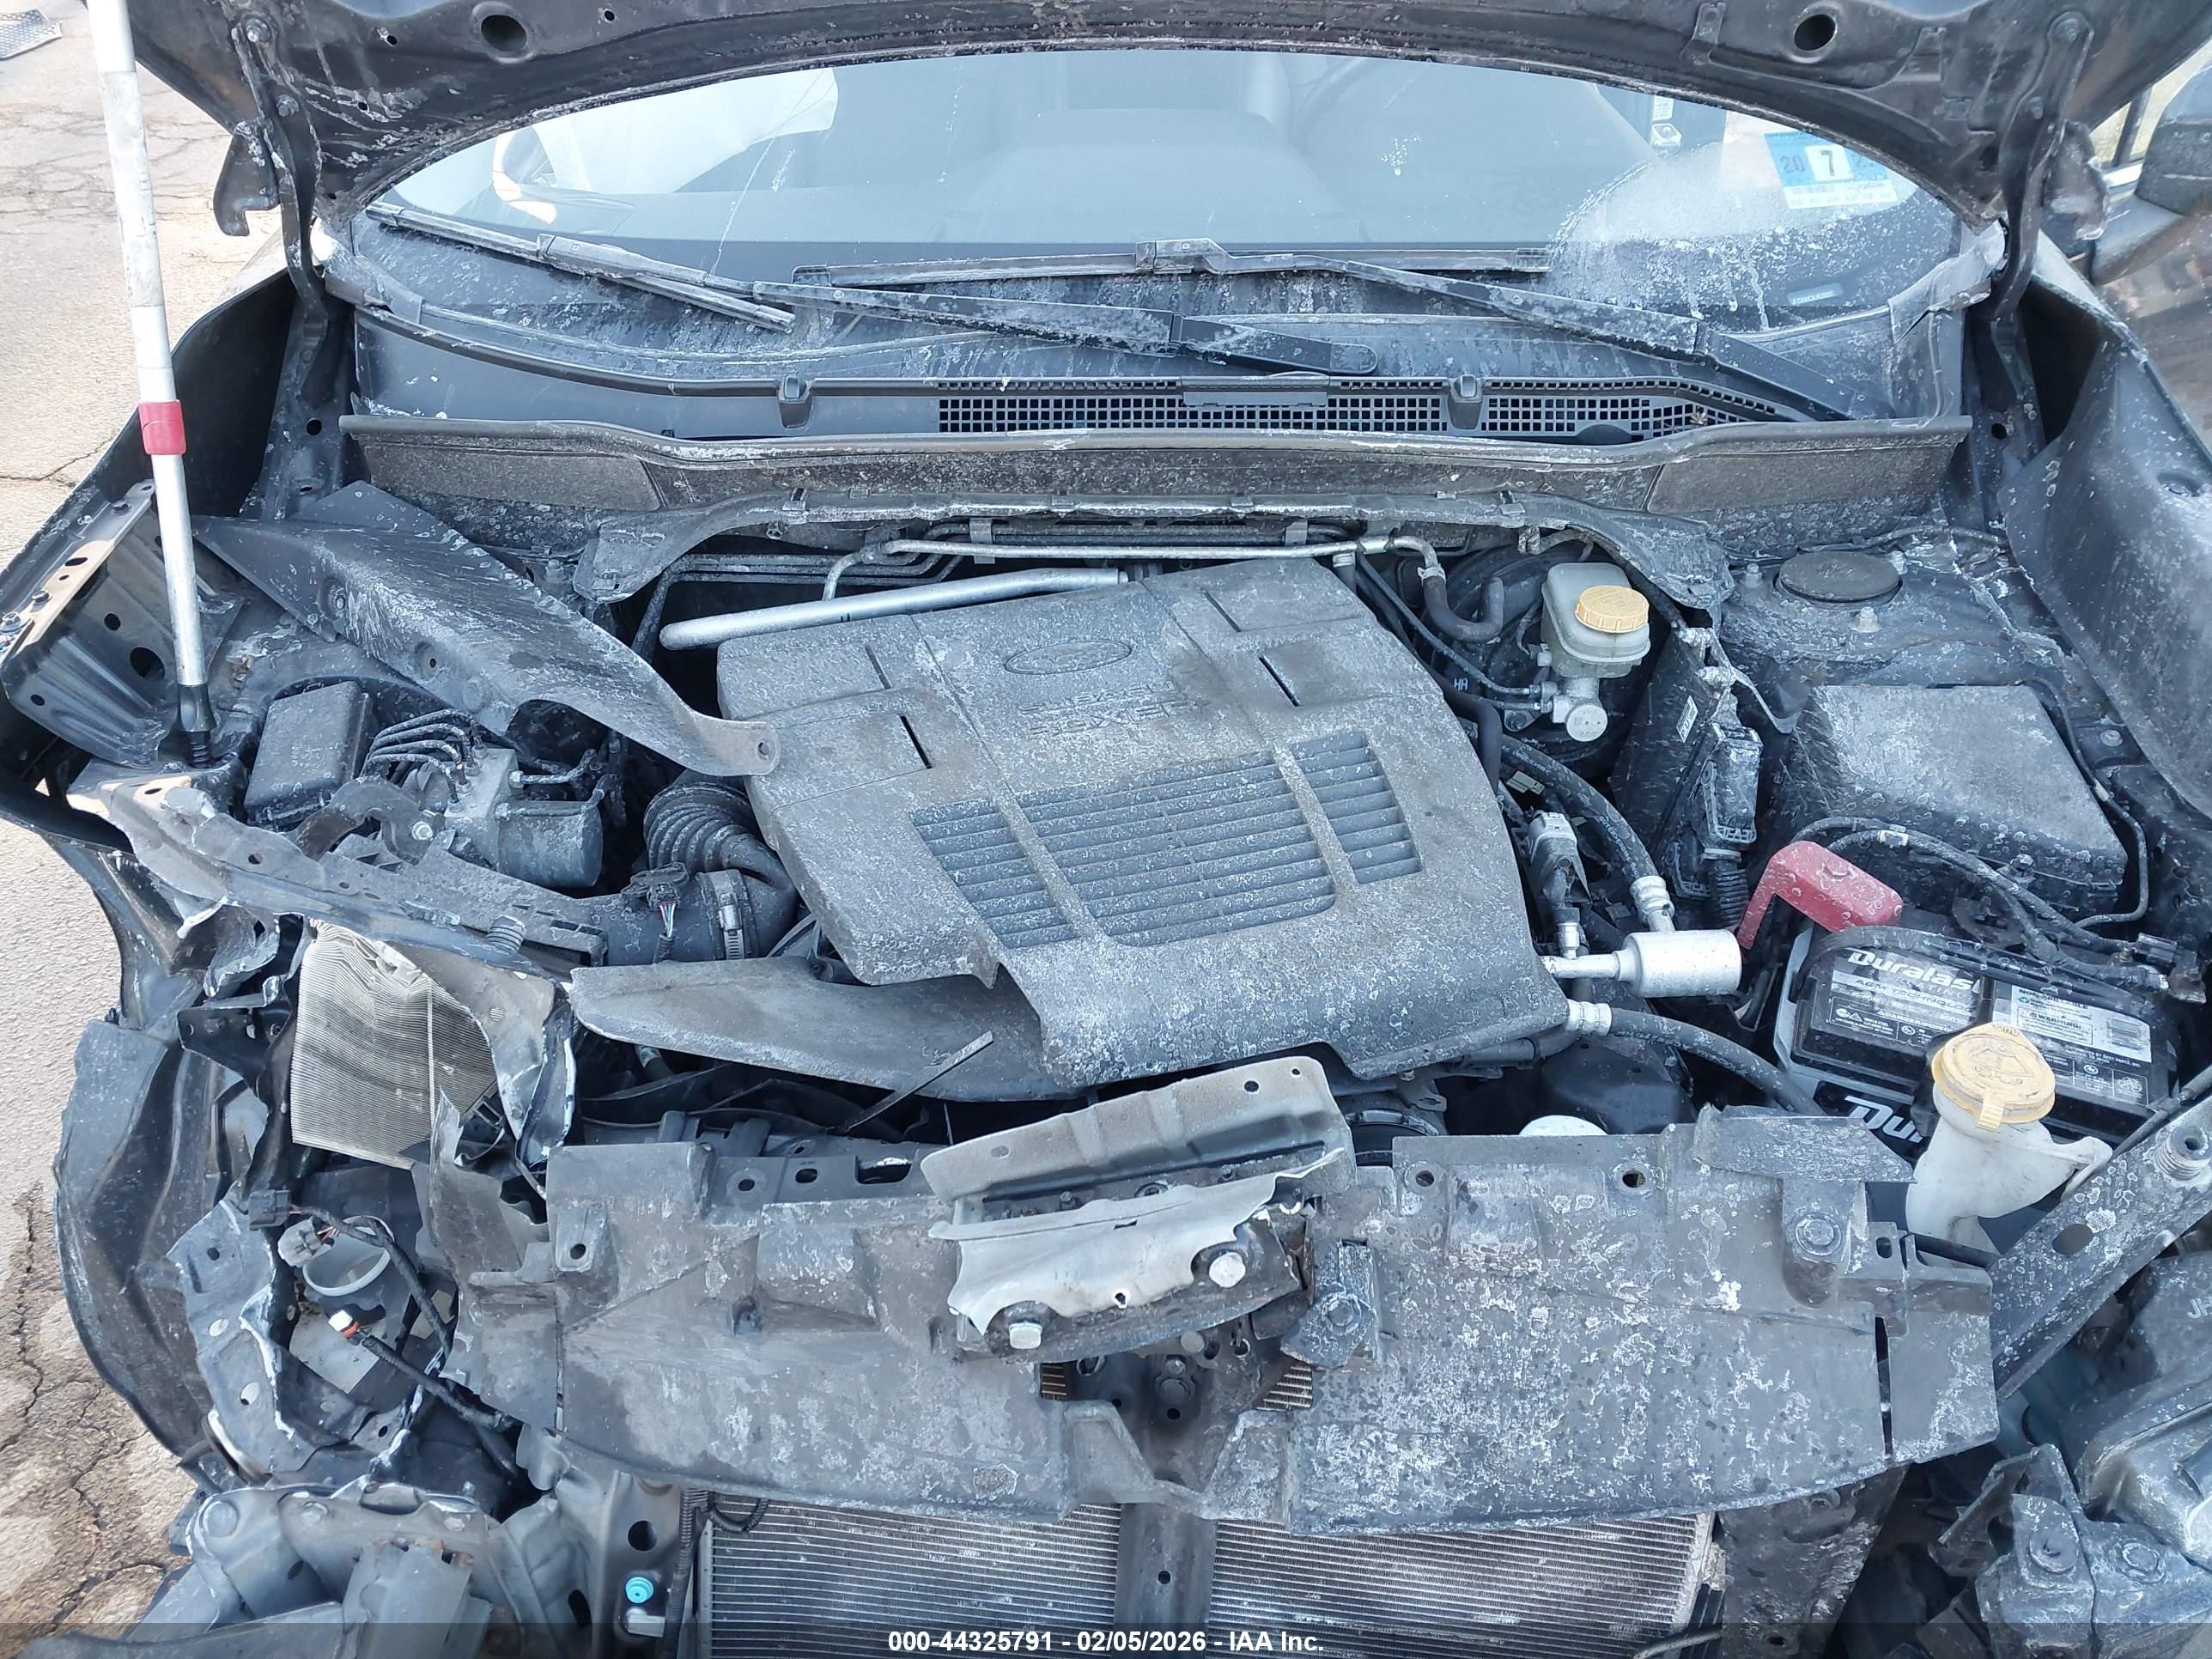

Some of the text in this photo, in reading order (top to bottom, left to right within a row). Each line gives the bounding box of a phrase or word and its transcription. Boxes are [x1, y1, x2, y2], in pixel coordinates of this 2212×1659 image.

[1780, 155, 1805, 173] 20
[1820, 149, 1836, 177] 7
[1018, 680, 1179, 718] SUBARU
[1024, 699, 1204, 738] BOXER
[1855, 979, 1886, 991] AGM
[1844, 1095, 1923, 1144] Du
